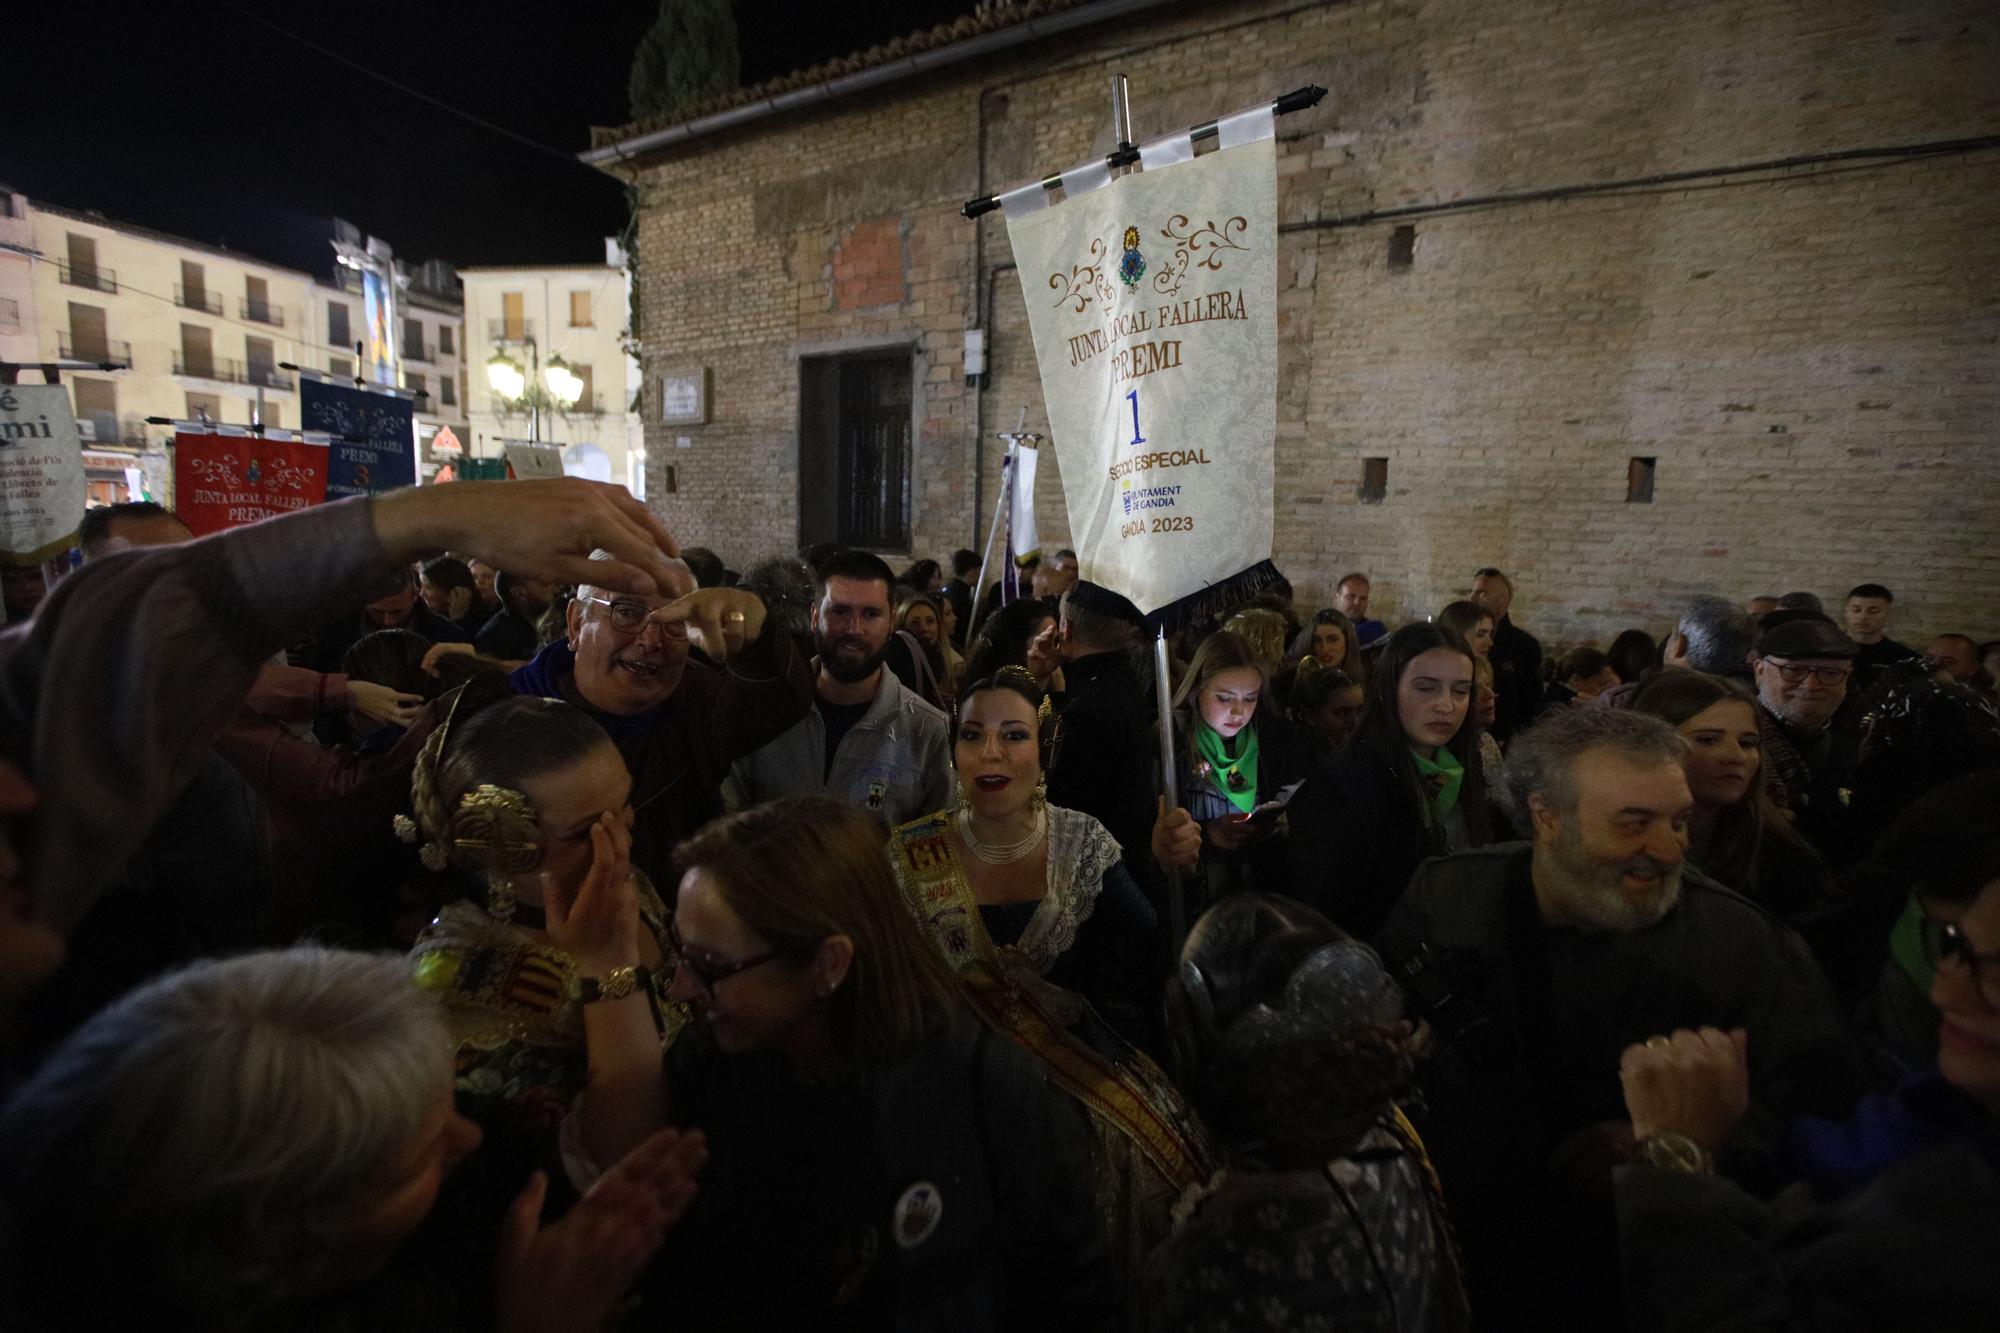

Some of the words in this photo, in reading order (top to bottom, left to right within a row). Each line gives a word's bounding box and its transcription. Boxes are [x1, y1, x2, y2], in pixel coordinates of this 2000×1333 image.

[1068, 327, 1109, 367] JUNTA
[1109, 311, 1152, 344] LOCAL
[1158, 288, 1248, 328] FALLERA
[1111, 340, 1183, 383] PREMI
[0, 414, 54, 438] mi
[1126, 389, 1146, 445] 1
[341, 448, 378, 464] PREMI
[1135, 449, 1211, 472] ESPECIAL
[352, 464, 369, 487] 3
[193, 489, 228, 504] JUNTA
[228, 492, 262, 504] LOCAL
[265, 494, 311, 511] FALLERA
[1140, 497, 1175, 509] GANDIA
[1152, 516, 1194, 533] 2023
[927, 880, 953, 902] 2023
